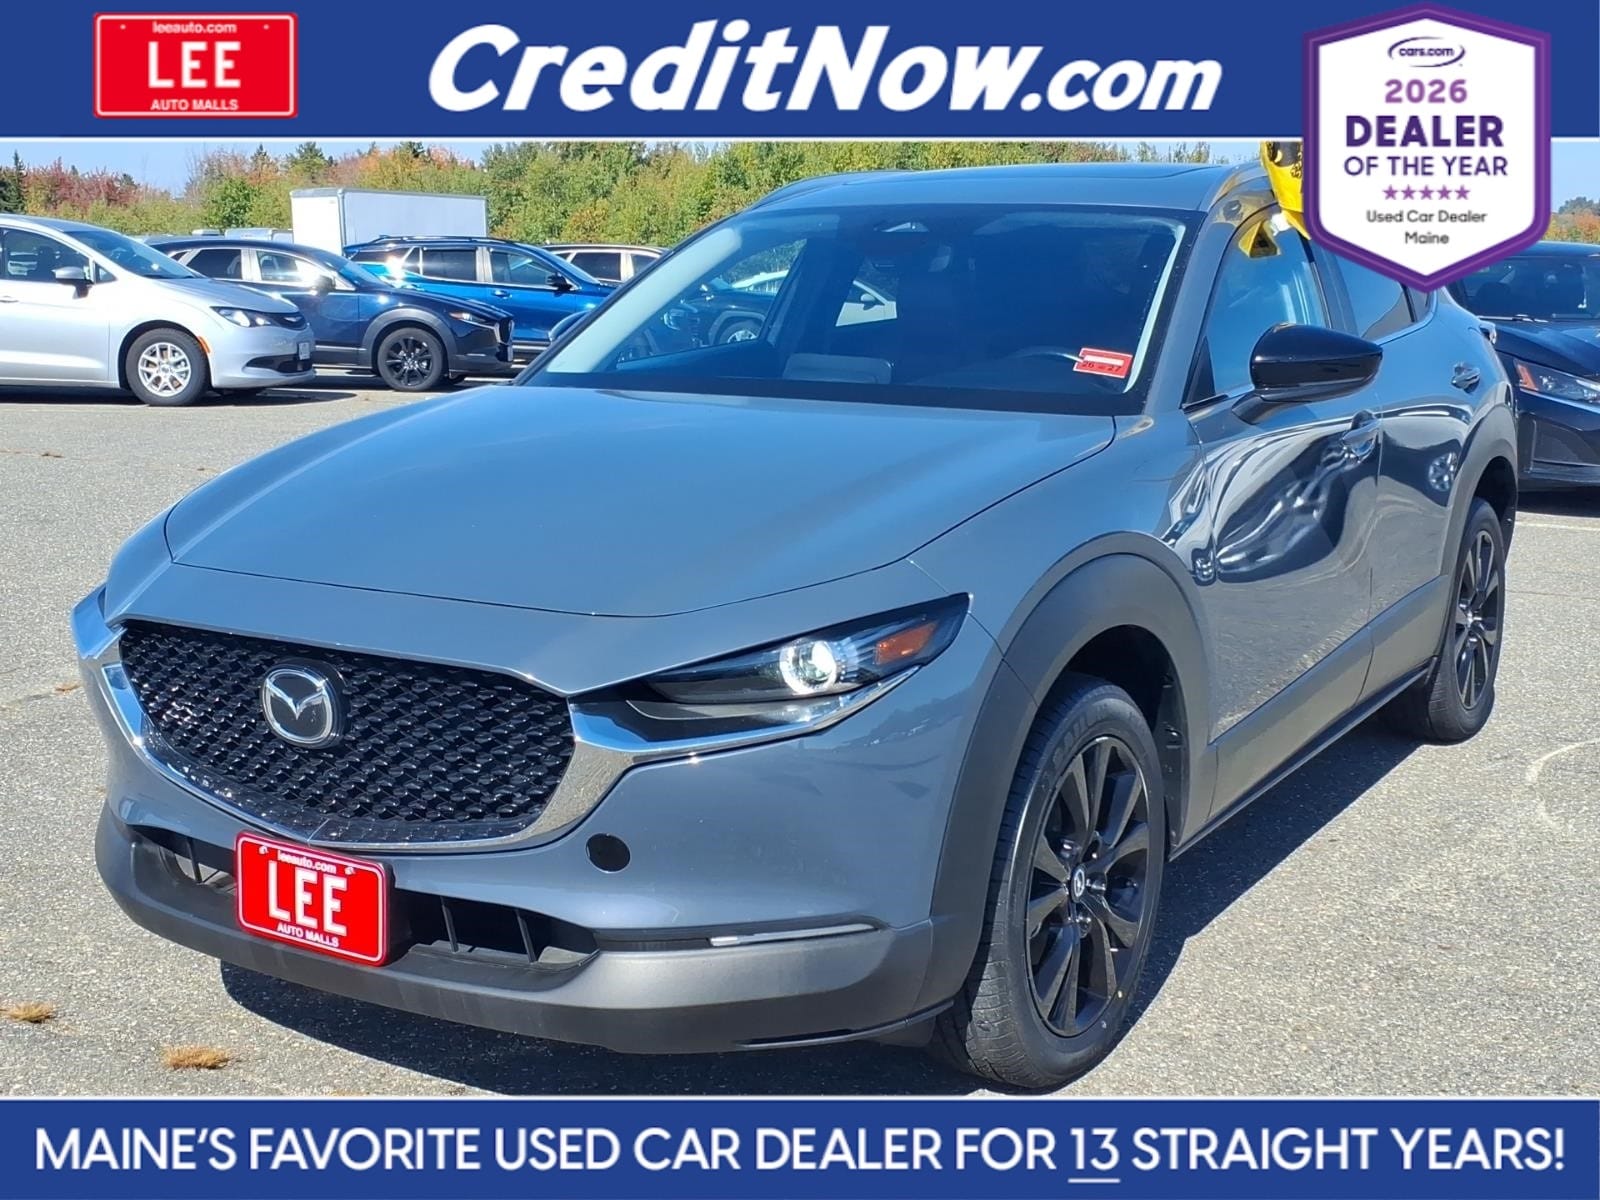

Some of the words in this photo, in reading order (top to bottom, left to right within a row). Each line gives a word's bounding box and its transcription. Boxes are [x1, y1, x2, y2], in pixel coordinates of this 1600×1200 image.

[277, 849, 337, 875] leeauto.com
[268, 860, 348, 936] LEE
[277, 923, 304, 939] AUTO
[305, 928, 340, 948] MALLS
